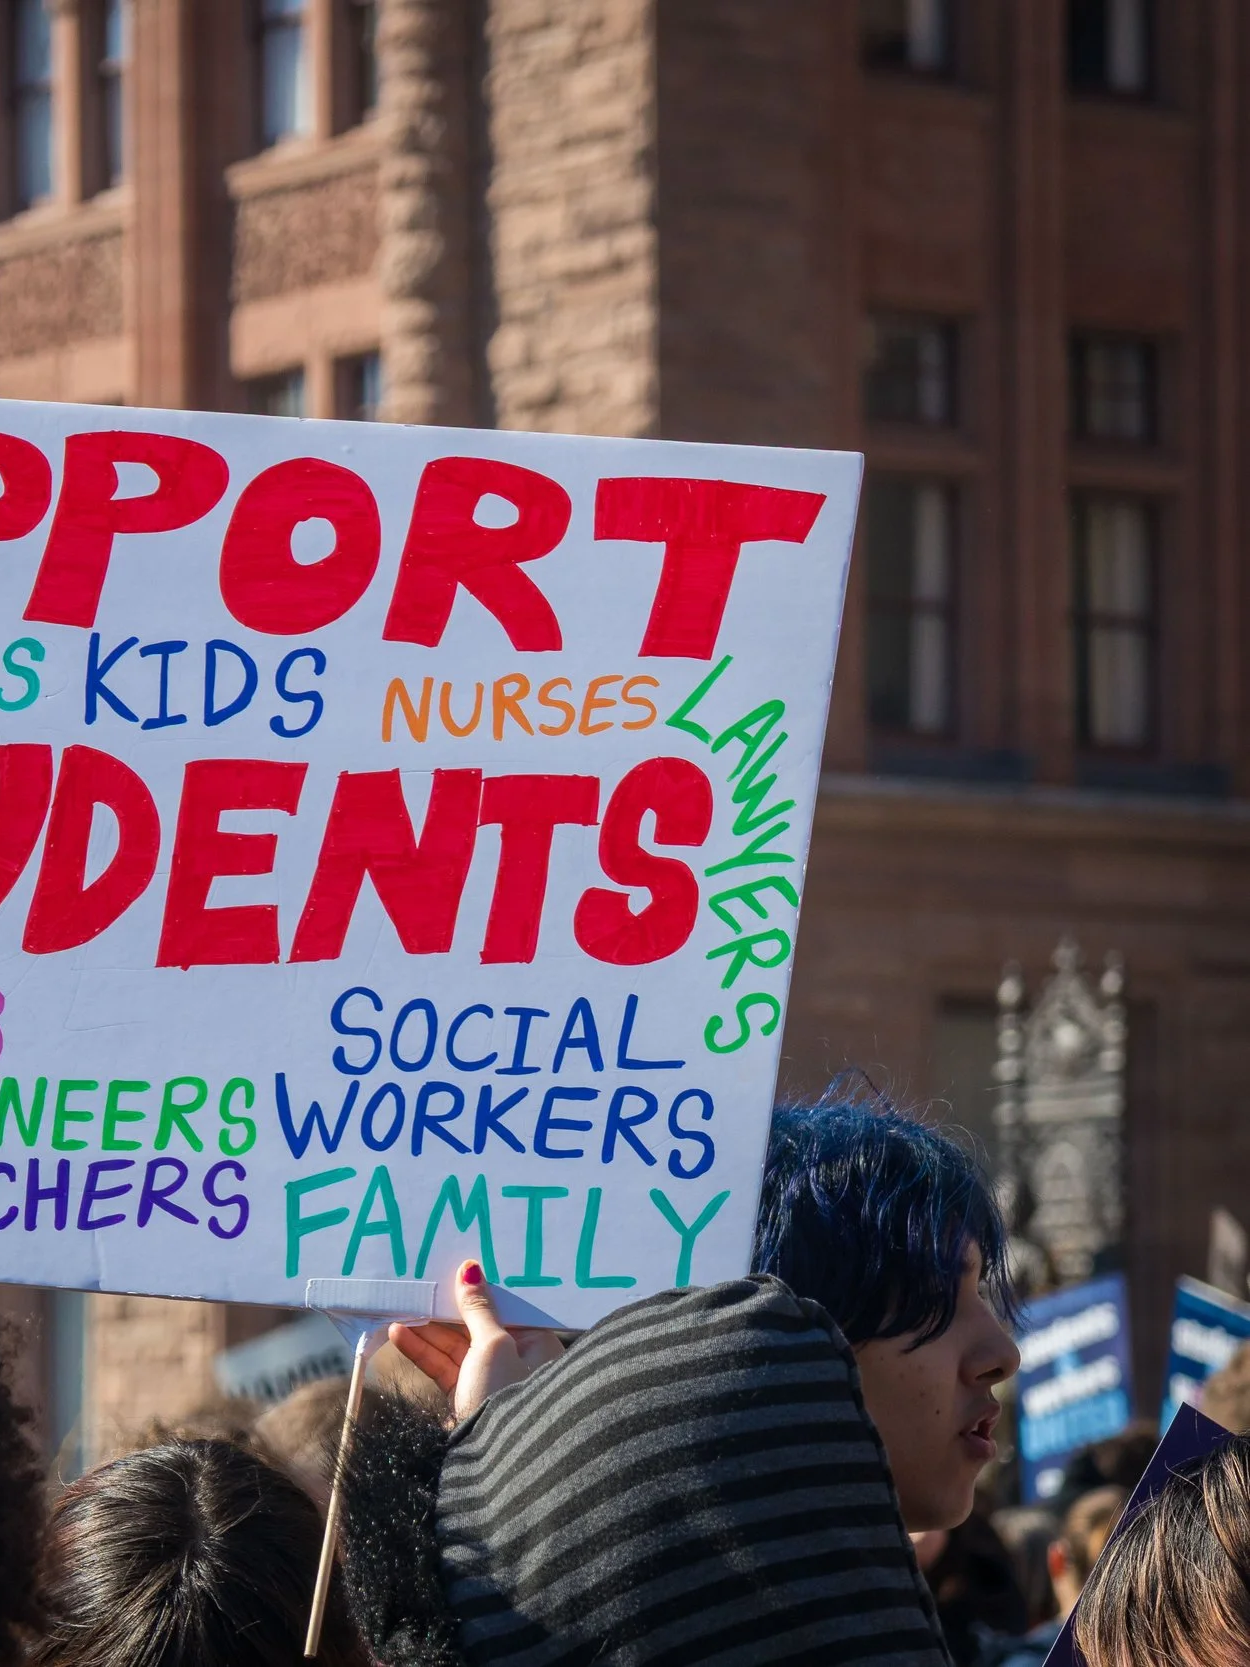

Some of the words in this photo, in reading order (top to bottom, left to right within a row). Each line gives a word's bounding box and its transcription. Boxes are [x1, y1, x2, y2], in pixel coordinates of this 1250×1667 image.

[84, 632, 327, 739] KIDS
[382, 672, 661, 743] NURSES
[665, 655, 800, 1054] LAWYERS
[330, 986, 686, 1076] SOCIAL
[275, 1071, 716, 1180] WORKERS
[284, 1164, 731, 1290] FAMILY
